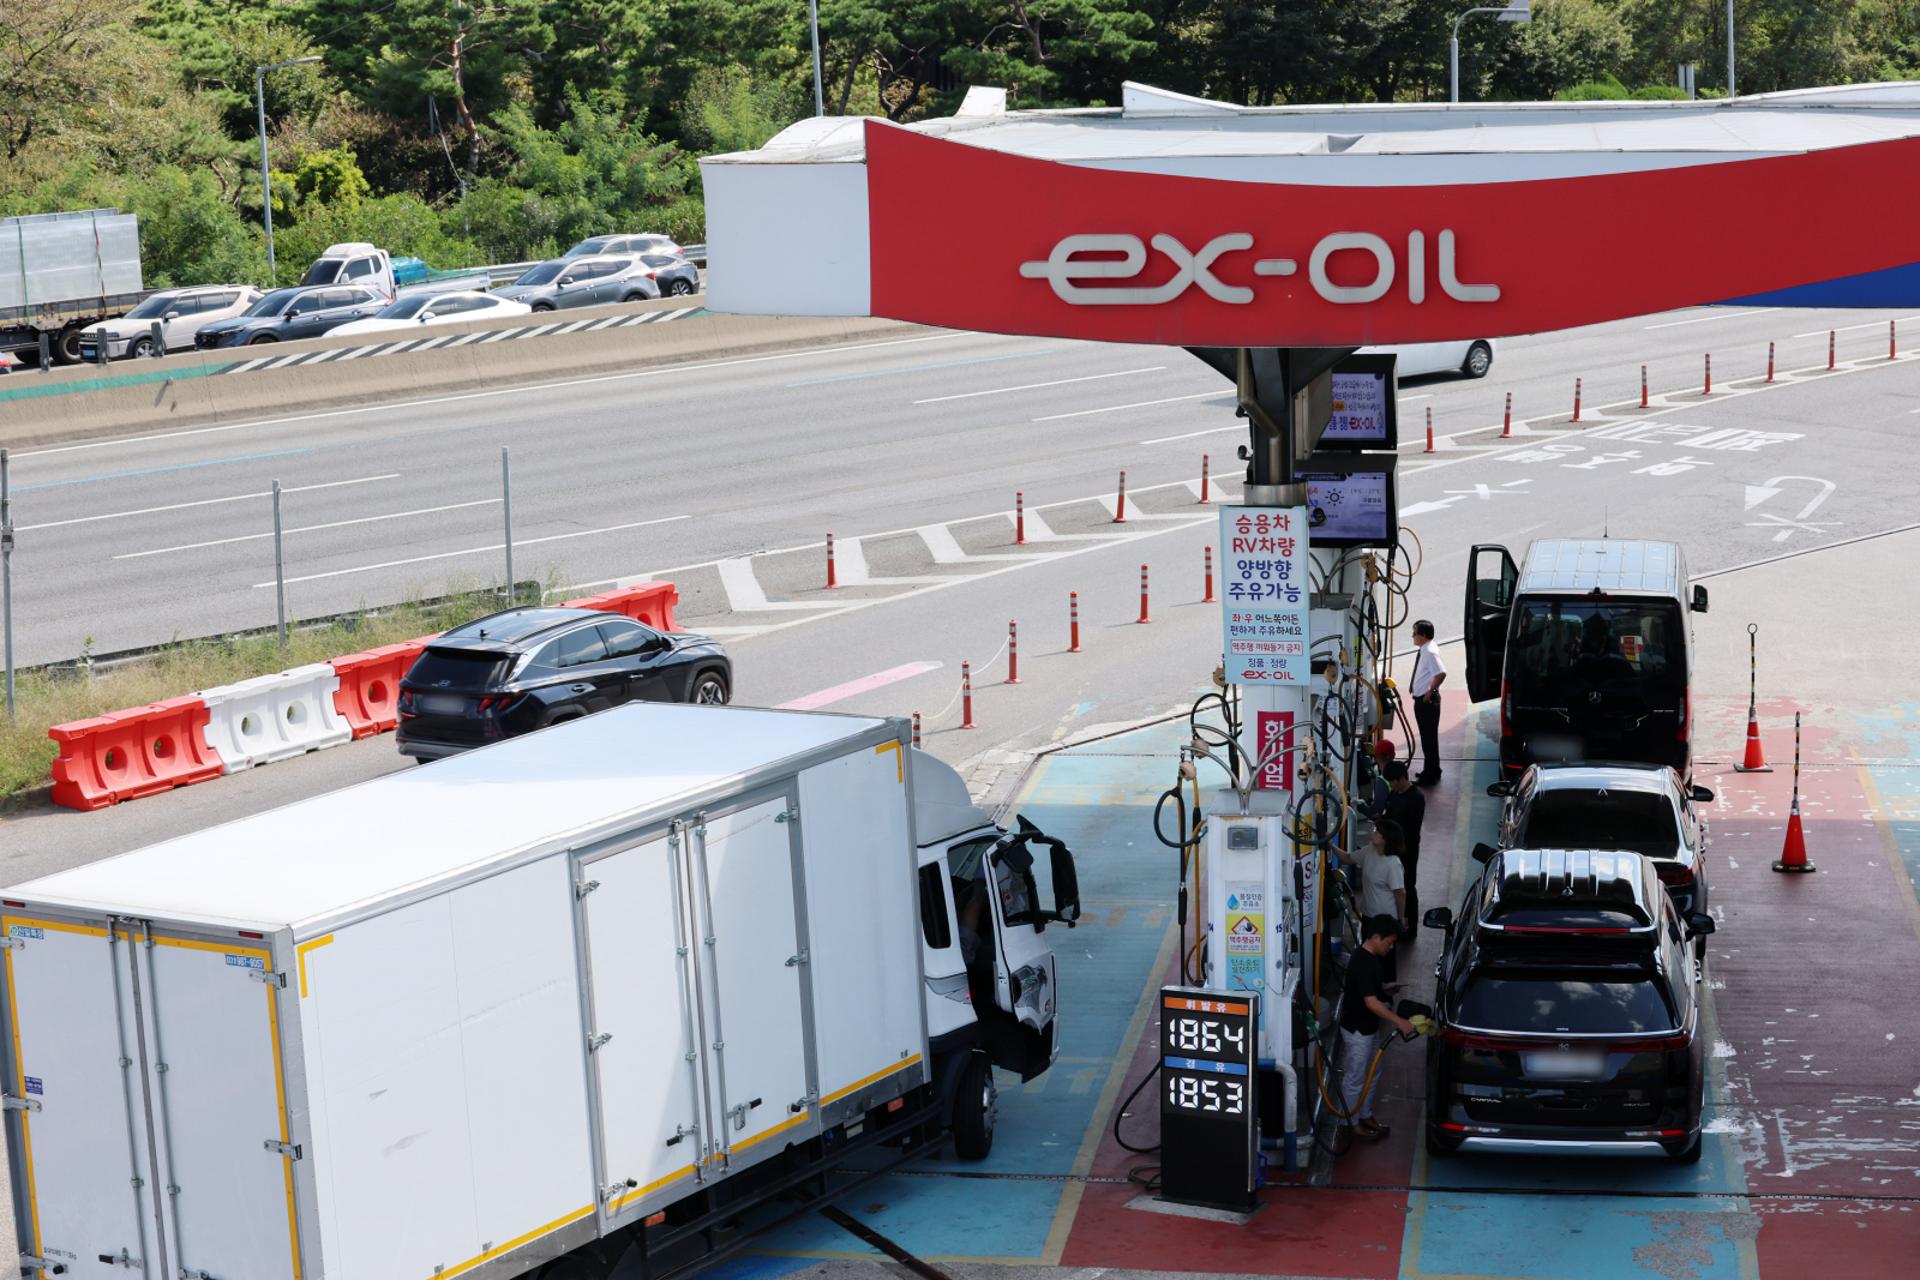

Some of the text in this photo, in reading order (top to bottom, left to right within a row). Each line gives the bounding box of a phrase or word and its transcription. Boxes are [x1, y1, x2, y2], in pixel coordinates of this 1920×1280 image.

[1019, 228, 1501, 305] ex-OIL
[1235, 514, 1291, 535] 승용차
[1232, 536, 1295, 557] RV차량
[1237, 559, 1292, 580] 양방향
[1228, 582, 1301, 603] 주유가능
[1255, 613, 1299, 625] 어느쪽이든
[1230, 625, 1303, 636] 편하게 주유하세요
[1232, 642, 1254, 652] 역주행
[1286, 643, 1301, 653] 금지
[1248, 658, 1265, 668] 정품
[1240, 670, 1295, 680] ex-OIL
[1264, 720, 1284, 790] 화기엄
[1169, 1018, 1244, 1055] 1864
[1169, 1076, 1243, 1114] 1853
